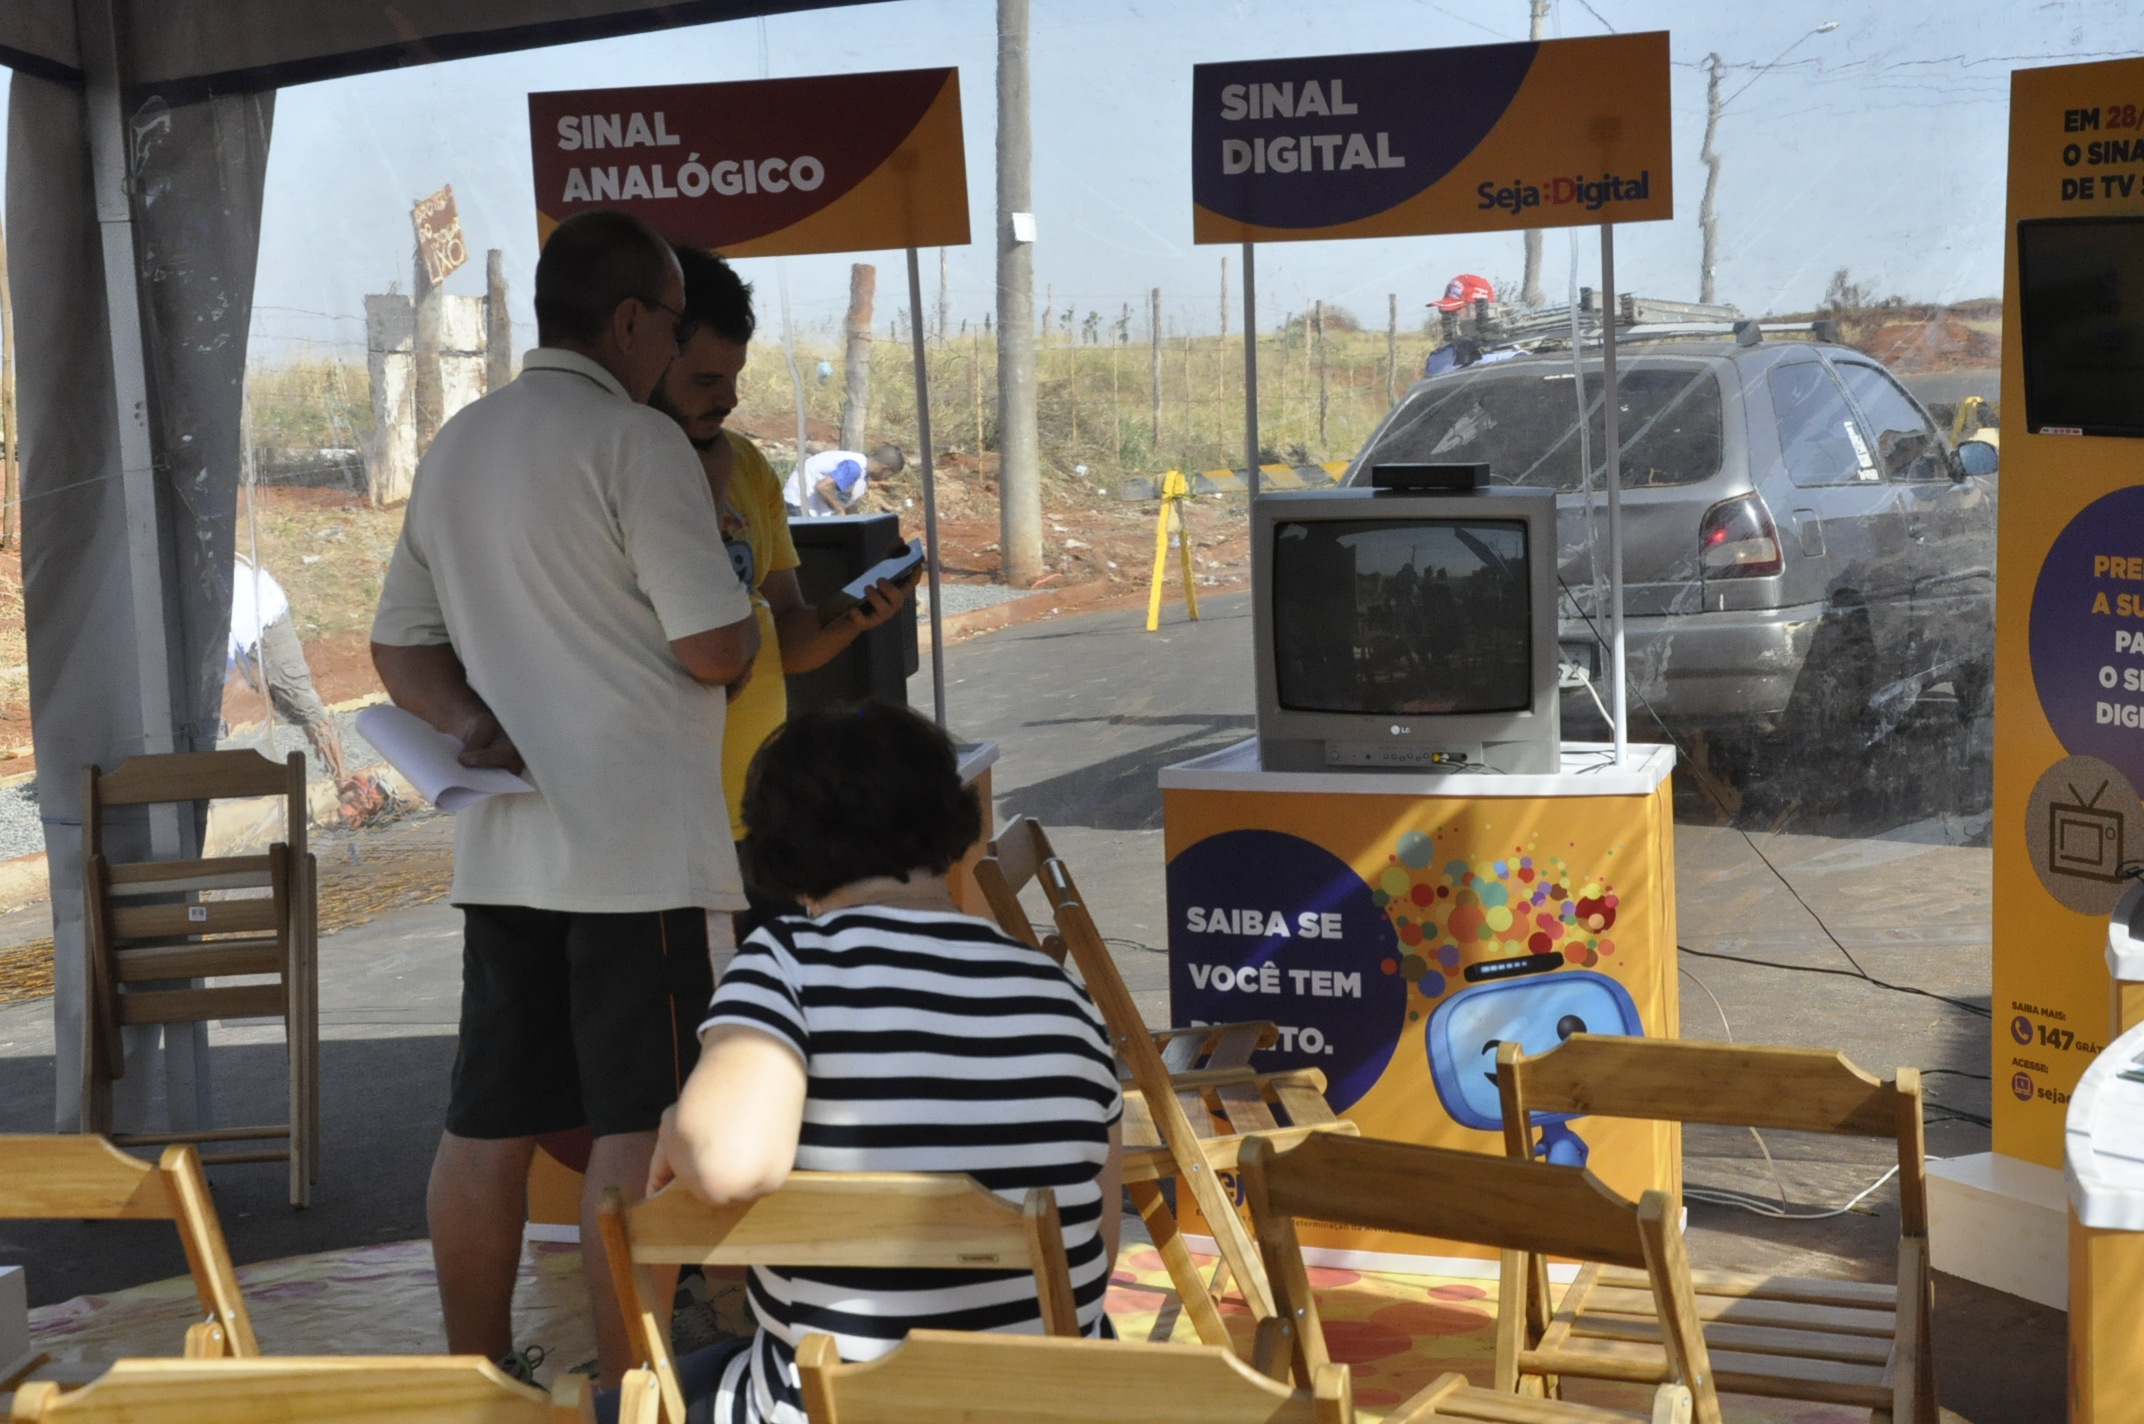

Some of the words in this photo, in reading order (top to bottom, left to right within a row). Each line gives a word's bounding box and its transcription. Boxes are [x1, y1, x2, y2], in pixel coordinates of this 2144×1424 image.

[1220, 79, 1358, 120] SINAL
[557, 111, 680, 150] SINAL
[2064, 107, 2100, 133] EM
[1222, 132, 1405, 175] DIGITAL
[2063, 143, 2081, 167] O
[562, 152, 825, 202] ANALÓGICO
[2062, 176, 2094, 201] DE
[2100, 174, 2135, 199] TV
[2094, 554, 2144, 580] PRE
[2091, 592, 2111, 615] A
[2098, 665, 2118, 689] O
[1186, 906, 1291, 937] SAIBA
[1298, 911, 1343, 939] SE
[1188, 961, 1281, 994] VOCÊ
[1289, 969, 1362, 998] TEM
[2011, 1001, 2039, 1015] SAIBA
[2041, 1007, 2066, 1021] MAIS:
[2037, 1025, 2075, 1051] 147
[2011, 1057, 2049, 1074] ACESSE:
